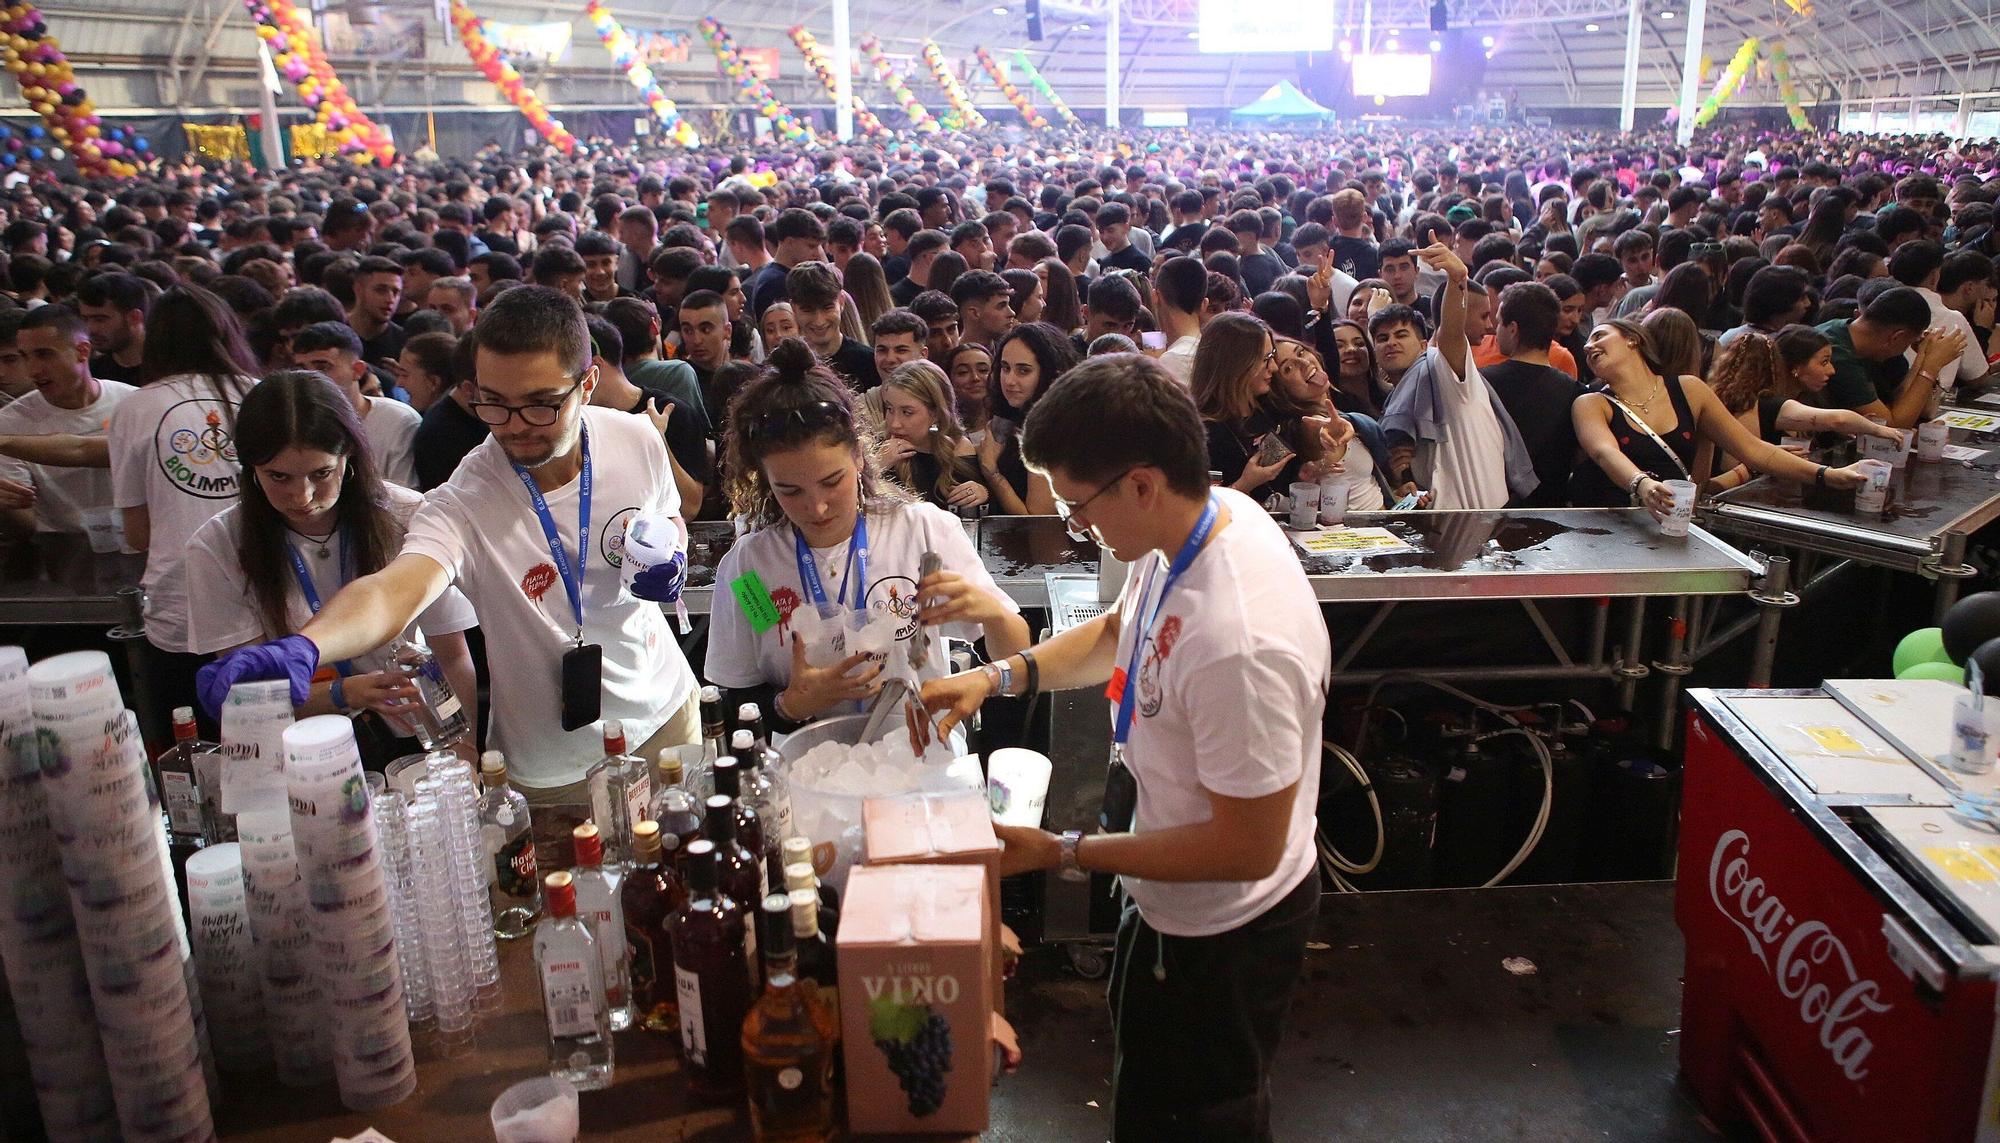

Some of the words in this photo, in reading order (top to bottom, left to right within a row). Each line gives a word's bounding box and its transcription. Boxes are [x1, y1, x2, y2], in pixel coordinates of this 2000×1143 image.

[165, 455, 240, 493] BIOLIMPI
[527, 480, 546, 511] E.Leclerc
[1709, 829, 1892, 1081] Coca-Cola
[861, 975, 960, 1005] VINO
